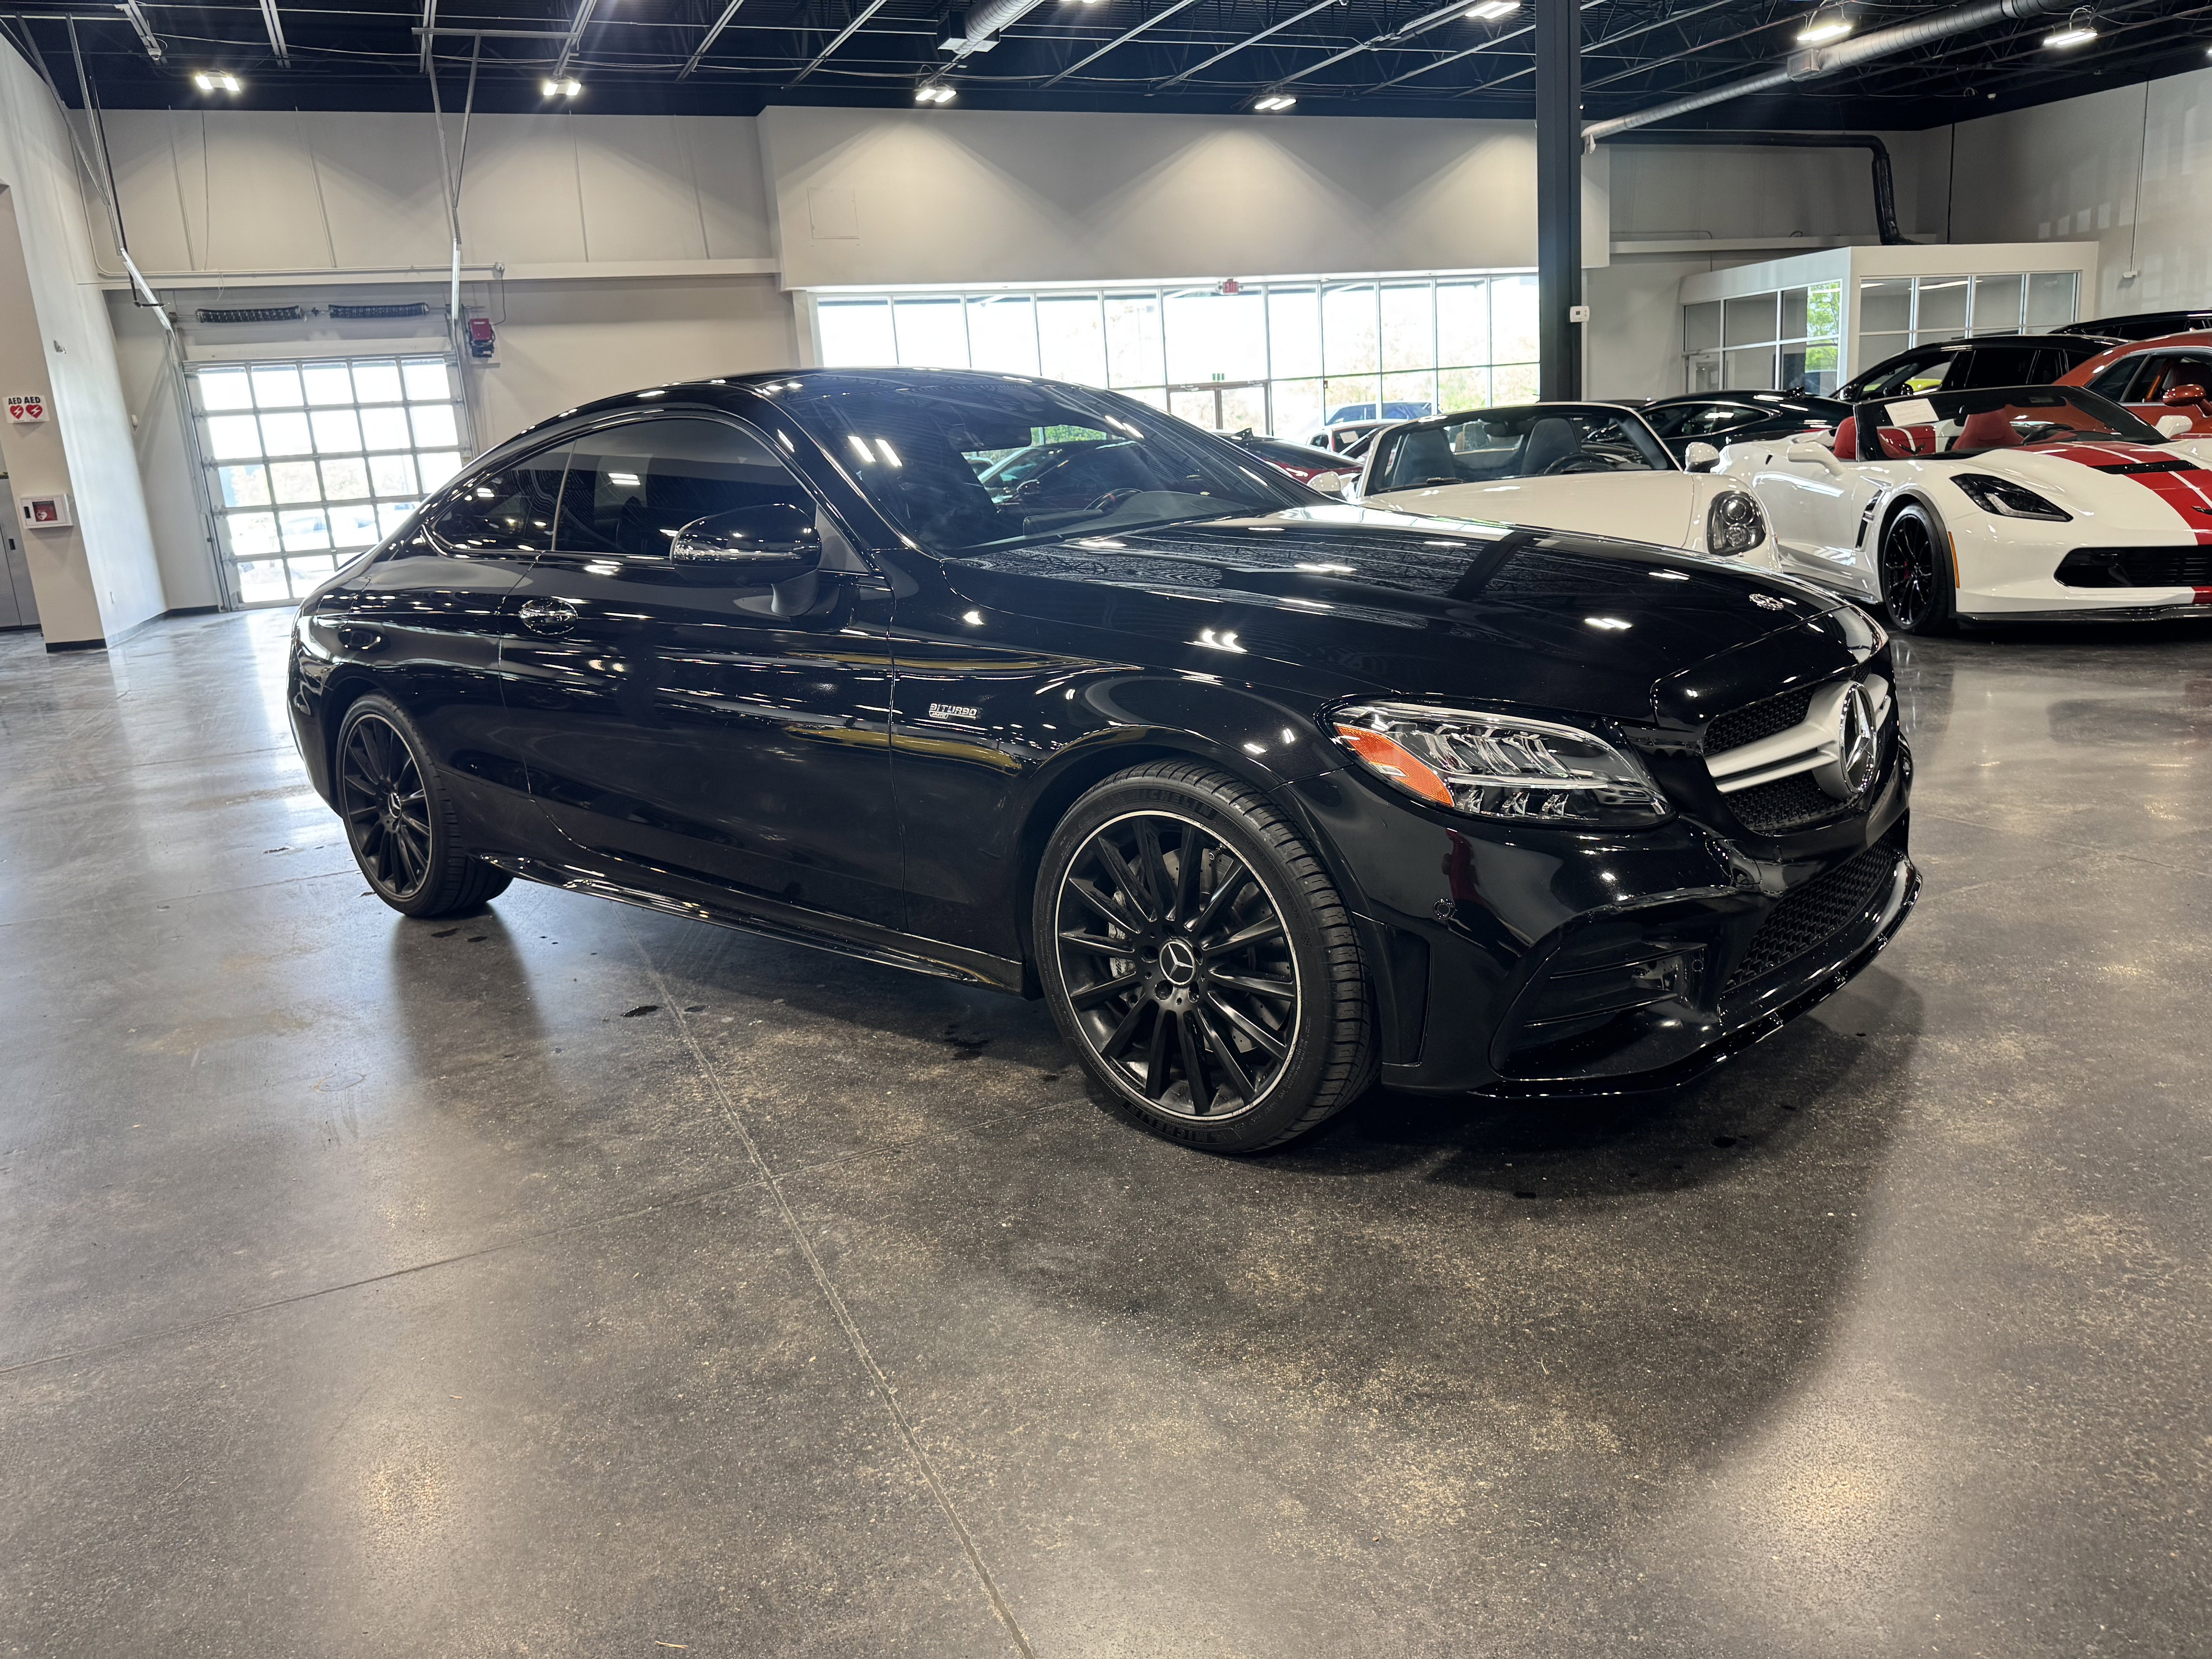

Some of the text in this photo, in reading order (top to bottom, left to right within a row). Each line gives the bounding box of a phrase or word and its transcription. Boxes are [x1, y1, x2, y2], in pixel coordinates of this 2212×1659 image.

[929, 703, 977, 716] BITURBO
[1223, 818, 1244, 838] PILOT
[1244, 837, 1267, 863] SPORT
[1279, 882, 1302, 921] SEASON
[1127, 1104, 1209, 1142] MICHELIN
